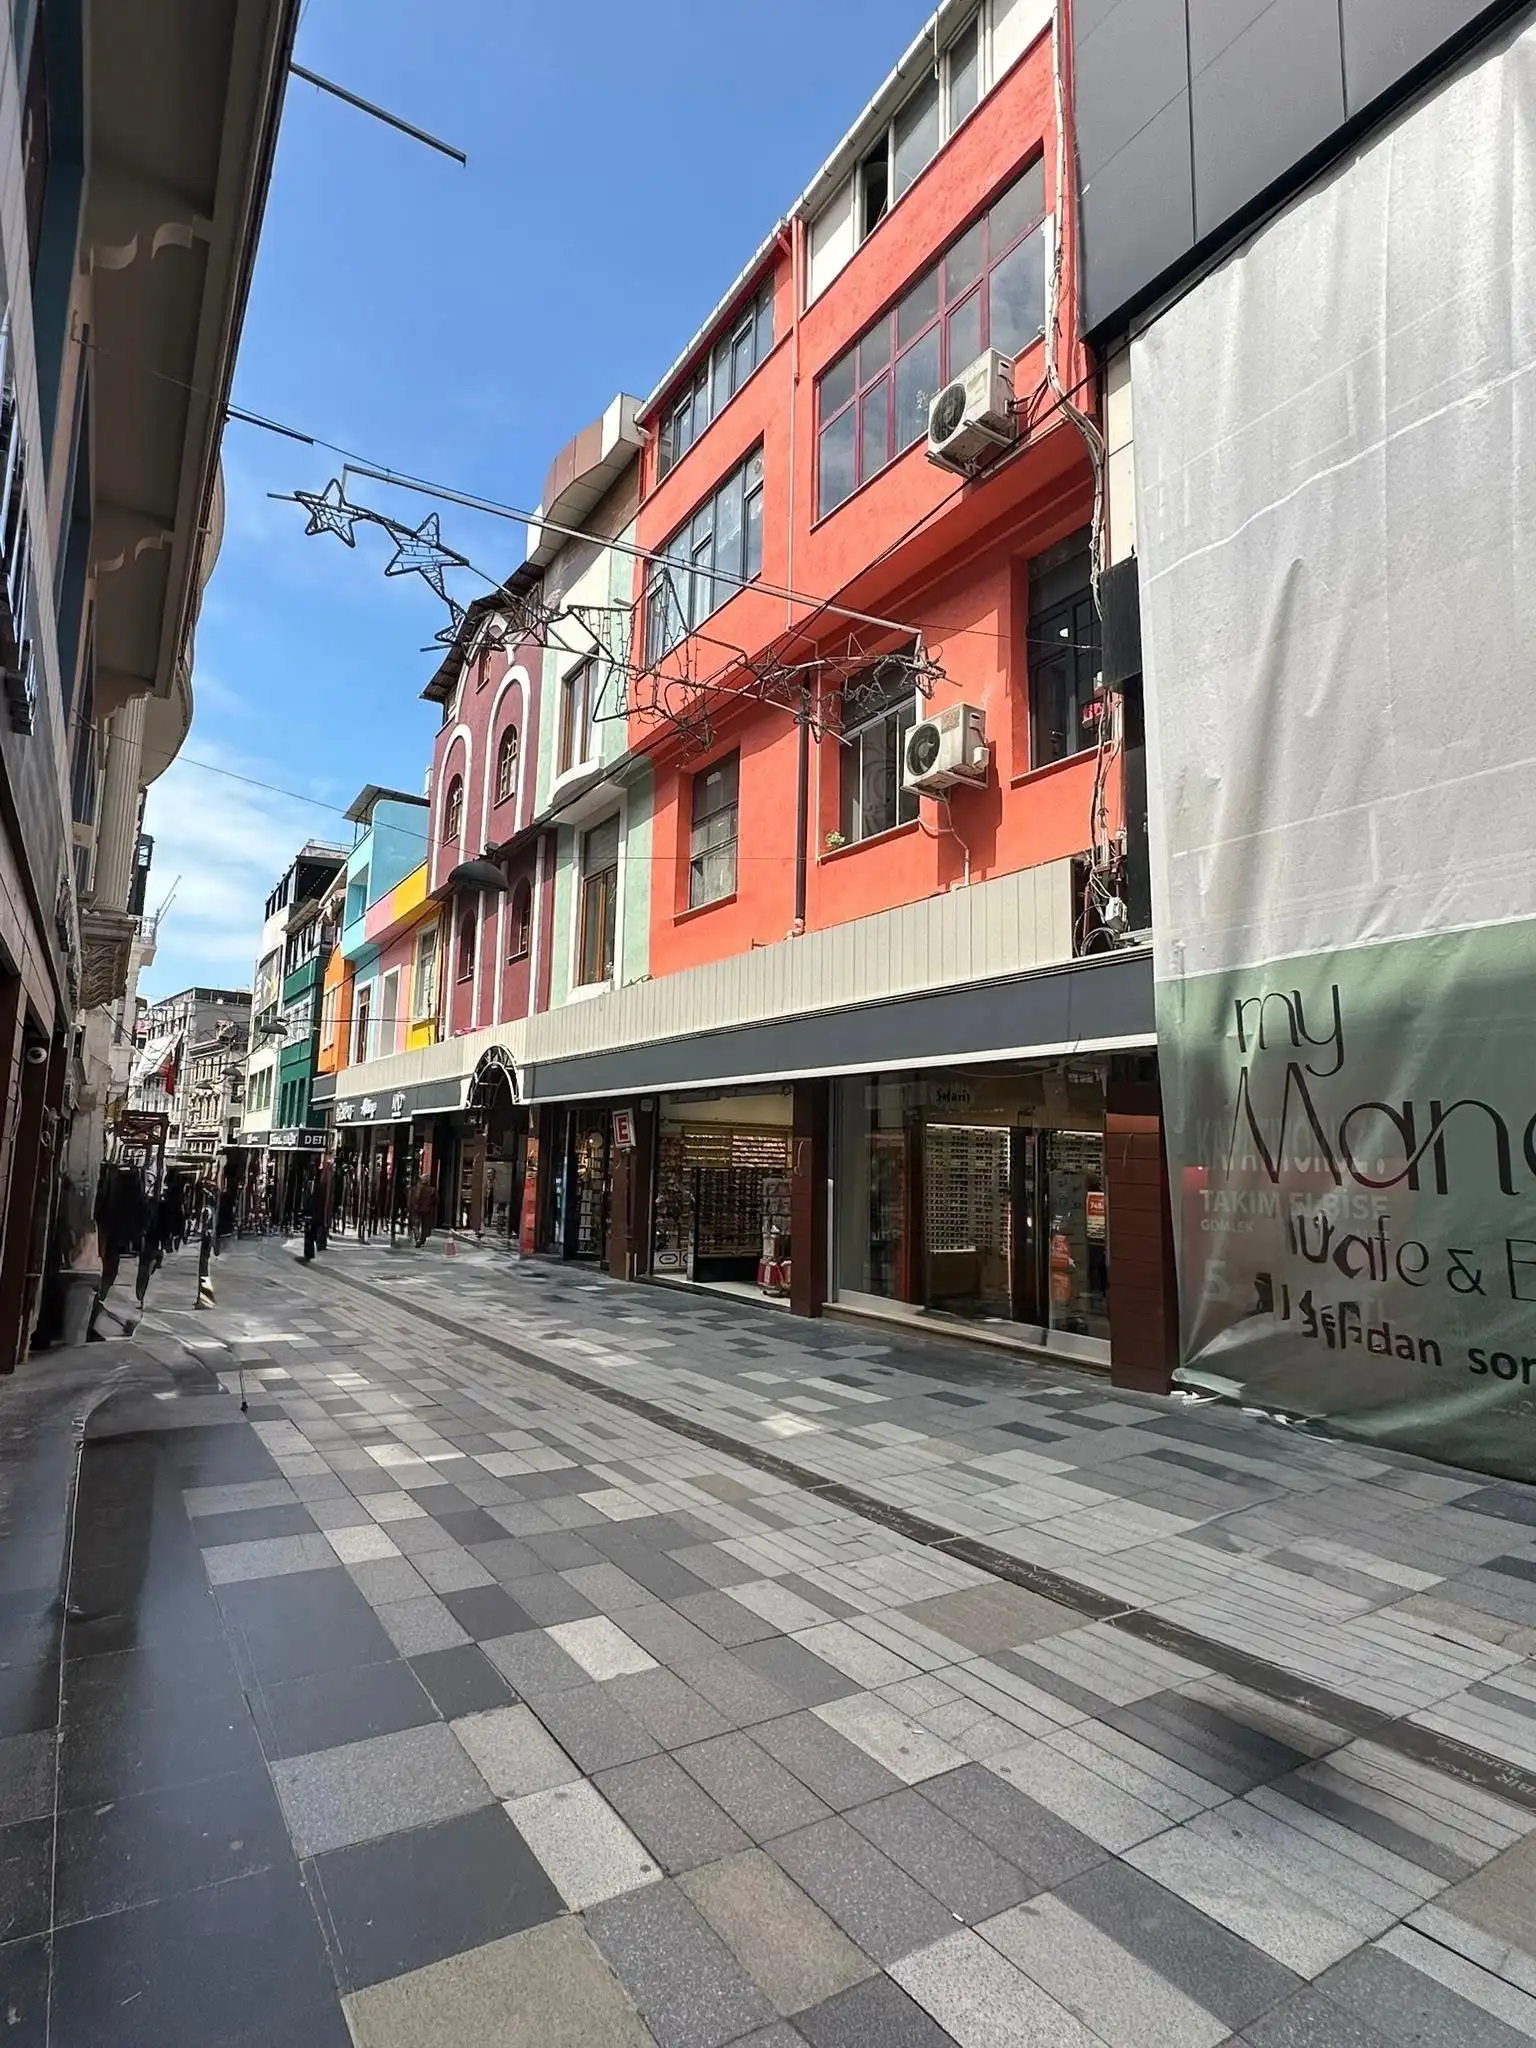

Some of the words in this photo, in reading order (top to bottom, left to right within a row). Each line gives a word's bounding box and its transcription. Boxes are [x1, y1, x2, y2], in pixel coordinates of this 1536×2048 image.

[1235, 985, 1344, 1077] my
[1199, 1189, 1279, 1217] TAKIM
[1447, 1247, 1486, 1296] &
